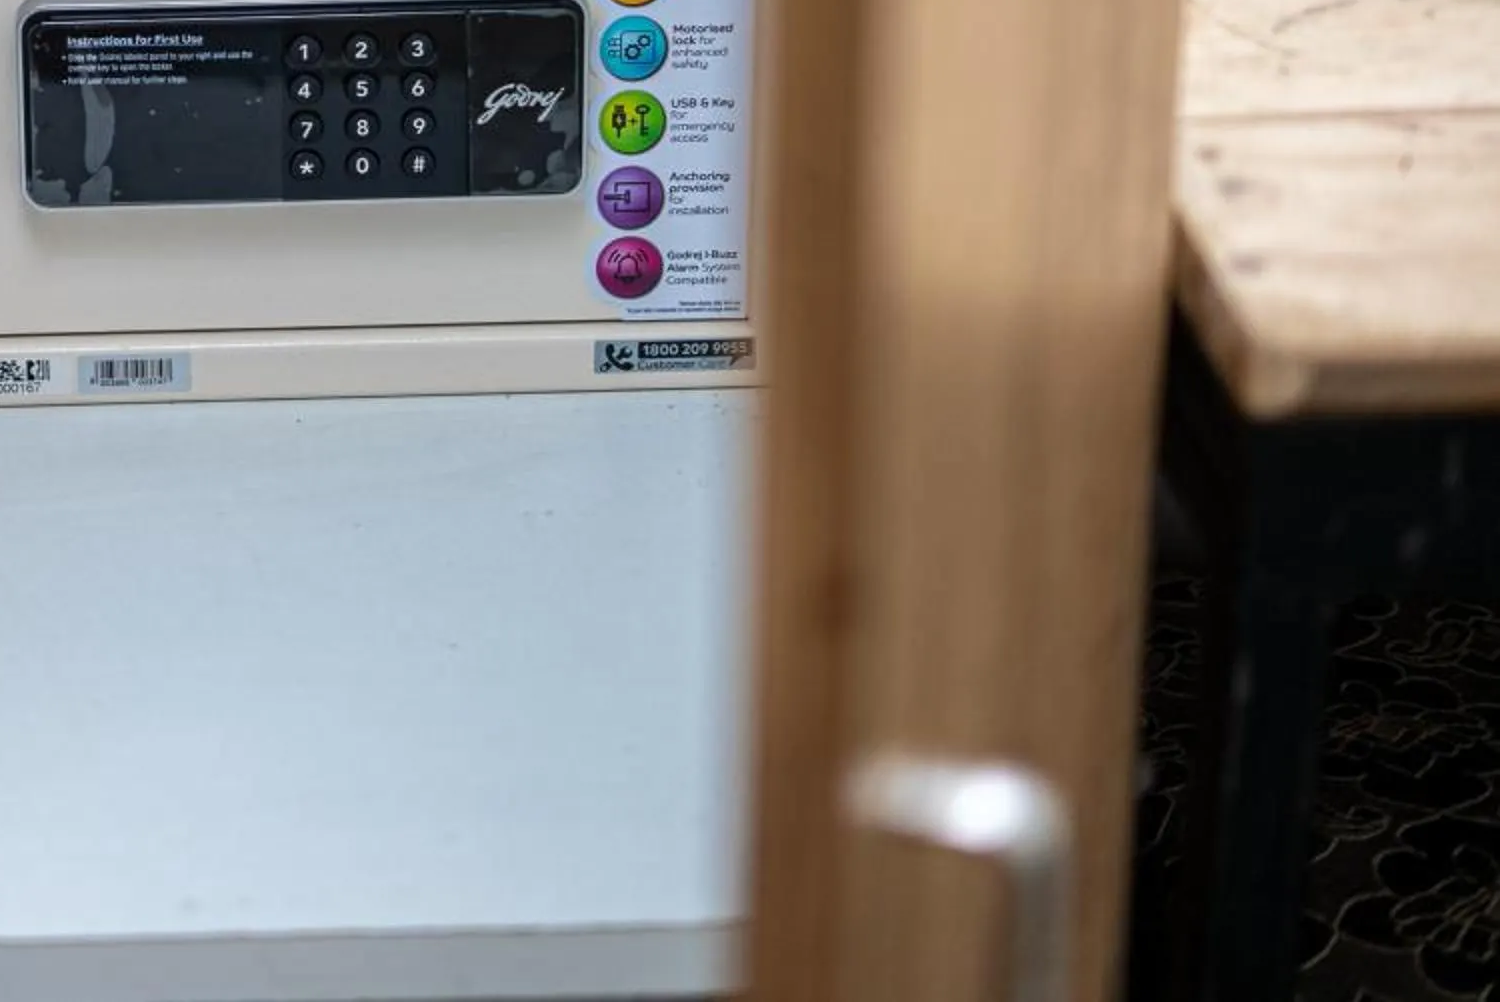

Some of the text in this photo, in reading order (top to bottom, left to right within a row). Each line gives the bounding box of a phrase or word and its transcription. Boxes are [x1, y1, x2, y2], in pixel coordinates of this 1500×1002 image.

[67, 32, 203, 48] Instructions for First Use
[672, 35, 716, 45] lock for
[298, 39, 425, 60] 1 2 3
[297, 78, 426, 99] 4 5 6
[476, 82, 565, 125] Godrej
[671, 97, 697, 108] USB
[711, 97, 735, 109] Key
[300, 116, 426, 139] 7 8 9
[670, 121, 735, 133] emergency
[670, 133, 709, 143] access
[355, 156, 369, 175] 0
[411, 155, 426, 174] #
[669, 170, 732, 183] Anchoring
[669, 183, 725, 194] provision
[668, 205, 730, 216] installation
[667, 250, 703, 262] Godrej
[667, 261, 741, 273] Alarm System
[666, 275, 728, 286] Compatible
[642, 343, 679, 356] 1800
[681, 342, 710, 355] 209
[637, 358, 696, 371] Customer
